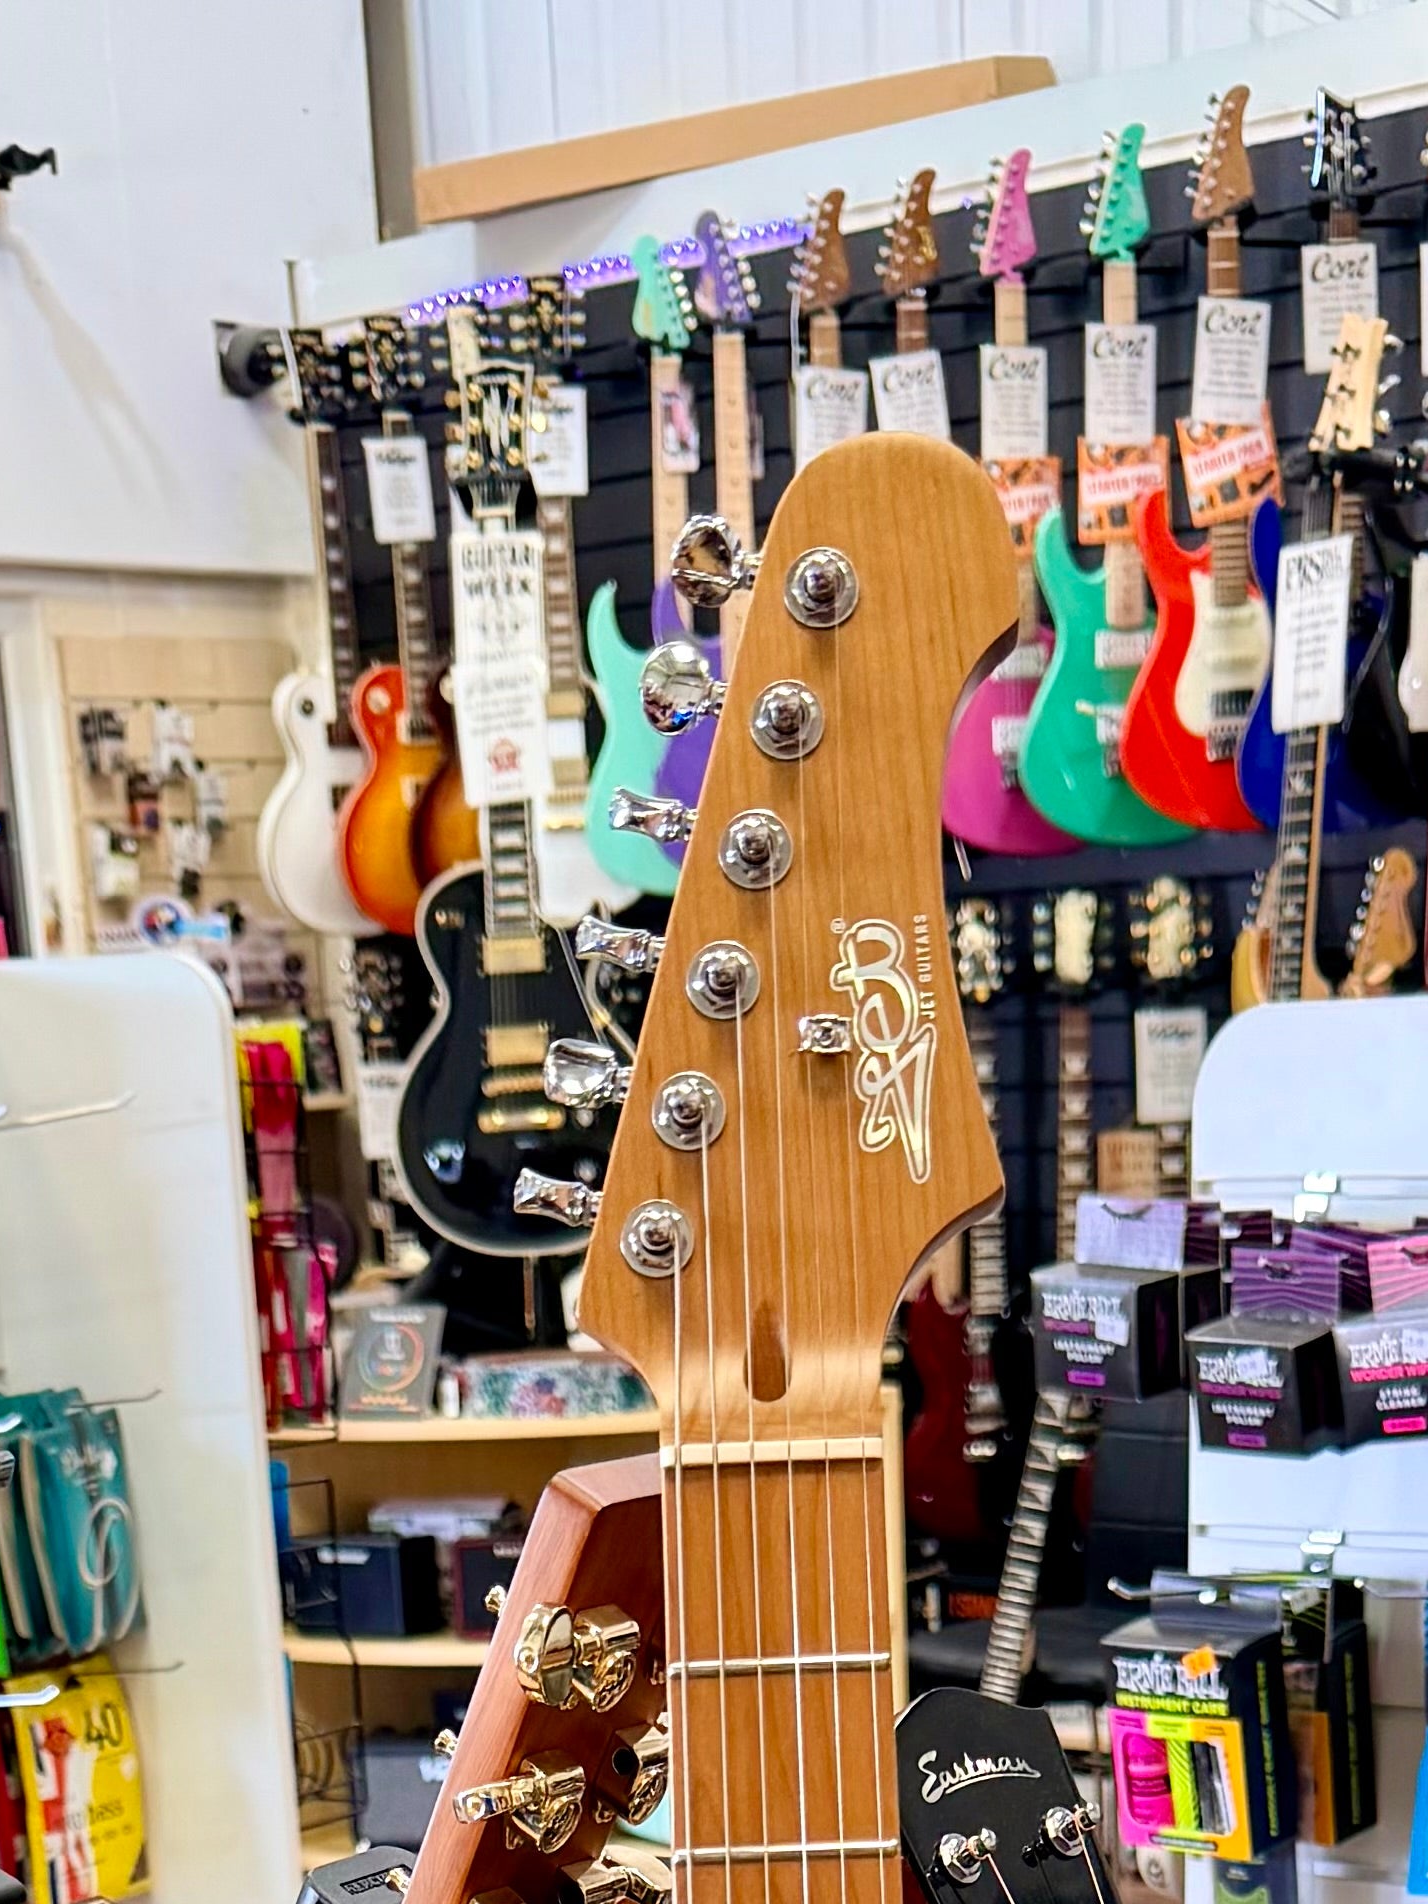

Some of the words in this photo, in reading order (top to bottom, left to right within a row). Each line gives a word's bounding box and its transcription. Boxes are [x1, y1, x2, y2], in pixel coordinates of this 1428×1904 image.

[913, 914, 932, 983] GUITARS
[920, 991, 937, 1020] JET
[1349, 1331, 1399, 1370] ERNIE
[1113, 1651, 1175, 1694] ERNIE
[1116, 1692, 1189, 1712] INSTRUMENT
[1192, 1700, 1230, 1717] CARE
[83, 1703, 123, 1751] 40
[917, 1748, 1042, 1806] Eastman
